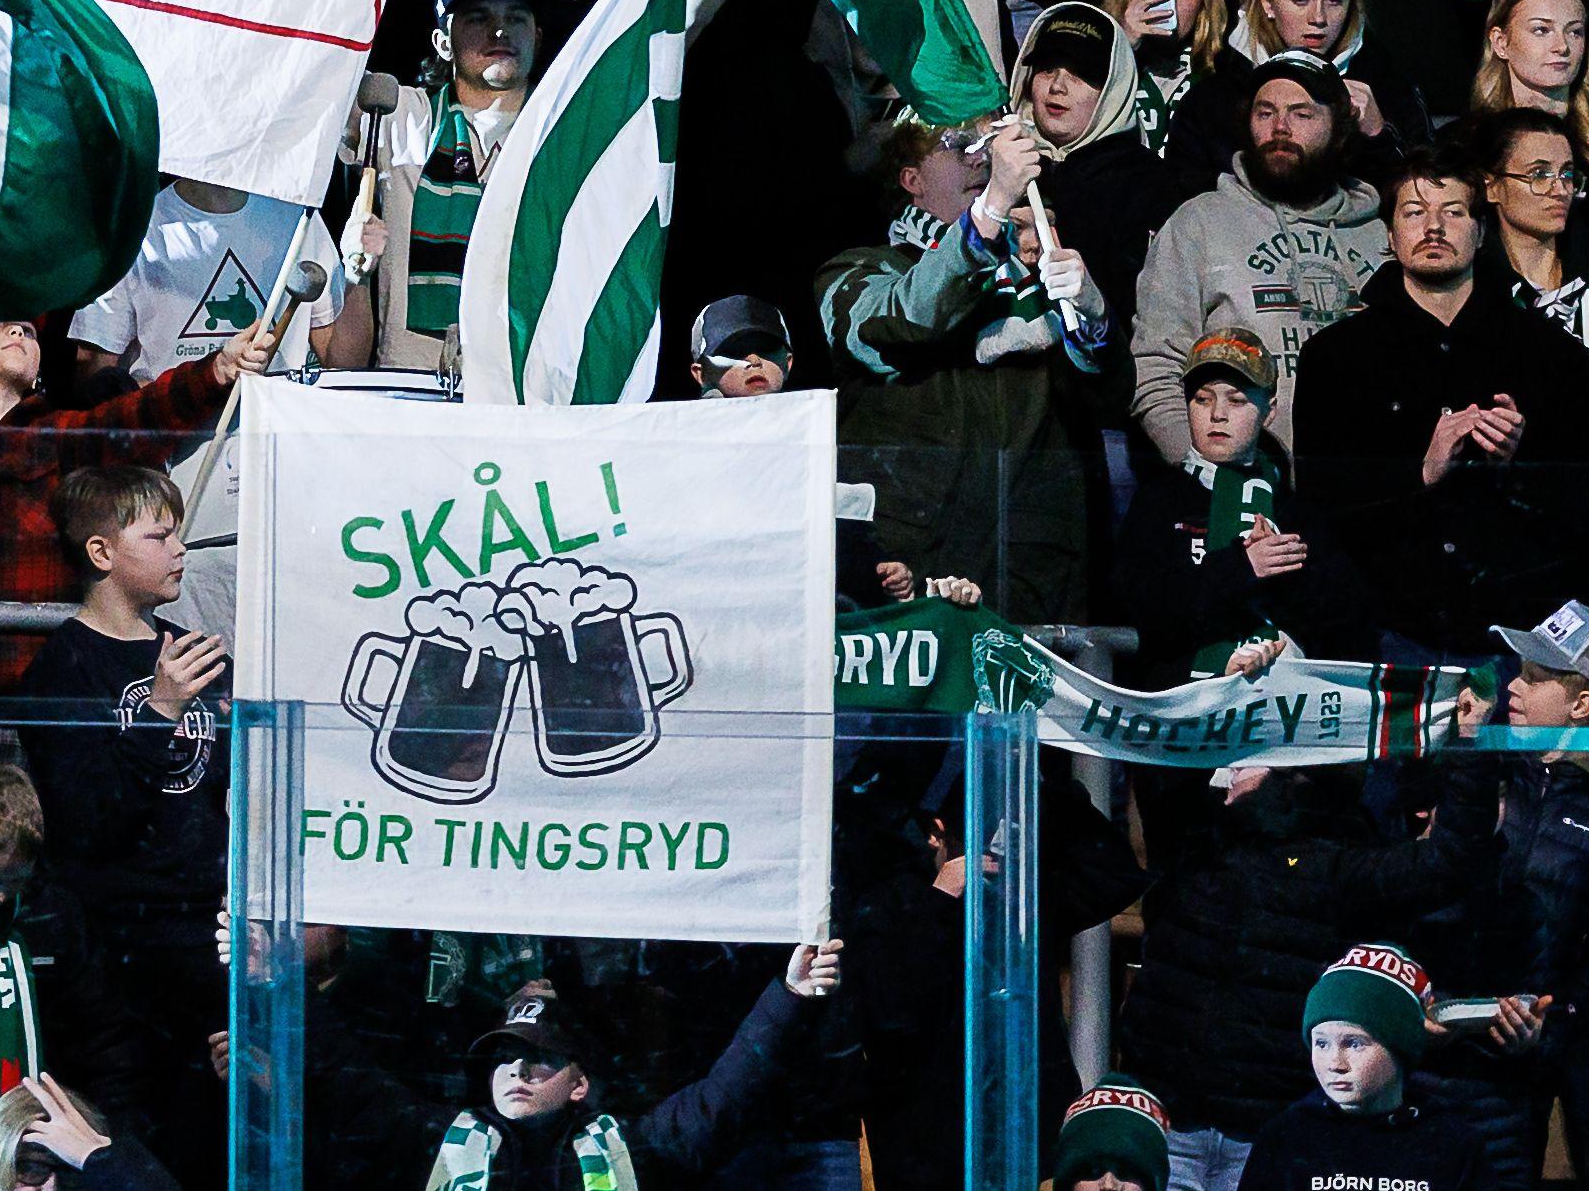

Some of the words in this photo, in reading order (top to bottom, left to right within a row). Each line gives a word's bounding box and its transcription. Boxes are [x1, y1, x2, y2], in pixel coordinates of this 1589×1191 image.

[341, 461, 628, 598] SKÅL!
[1079, 692, 1309, 753] HOCKEY
[300, 801, 415, 865] FÖR
[433, 819, 732, 872] TINGSRYD
[1311, 1172, 1374, 1191] BJÖRN
